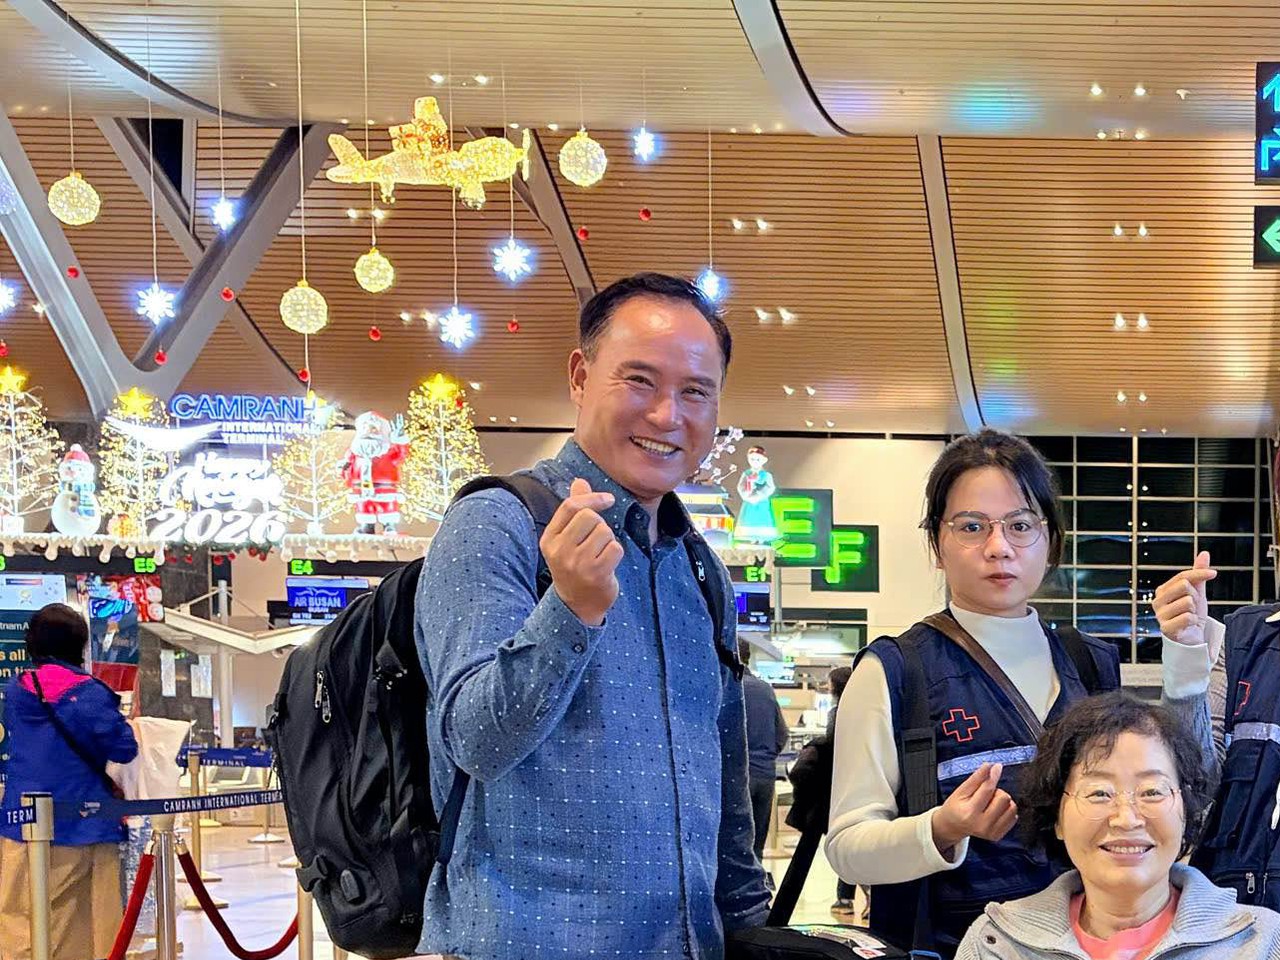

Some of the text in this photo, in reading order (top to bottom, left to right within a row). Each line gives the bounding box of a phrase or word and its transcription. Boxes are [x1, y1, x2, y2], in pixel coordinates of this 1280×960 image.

[148, 507, 287, 543] 2026
[771, 497, 816, 559] E
[134, 558, 157, 573] E5
[291, 559, 314, 575] E4
[825, 531, 864, 584] F
[308, 596, 342, 607] BUSAN
[9, 648, 26, 661] all
[163, 797, 202, 813] CAMRANH
[204, 790, 258, 809] INTERNATIONAL
